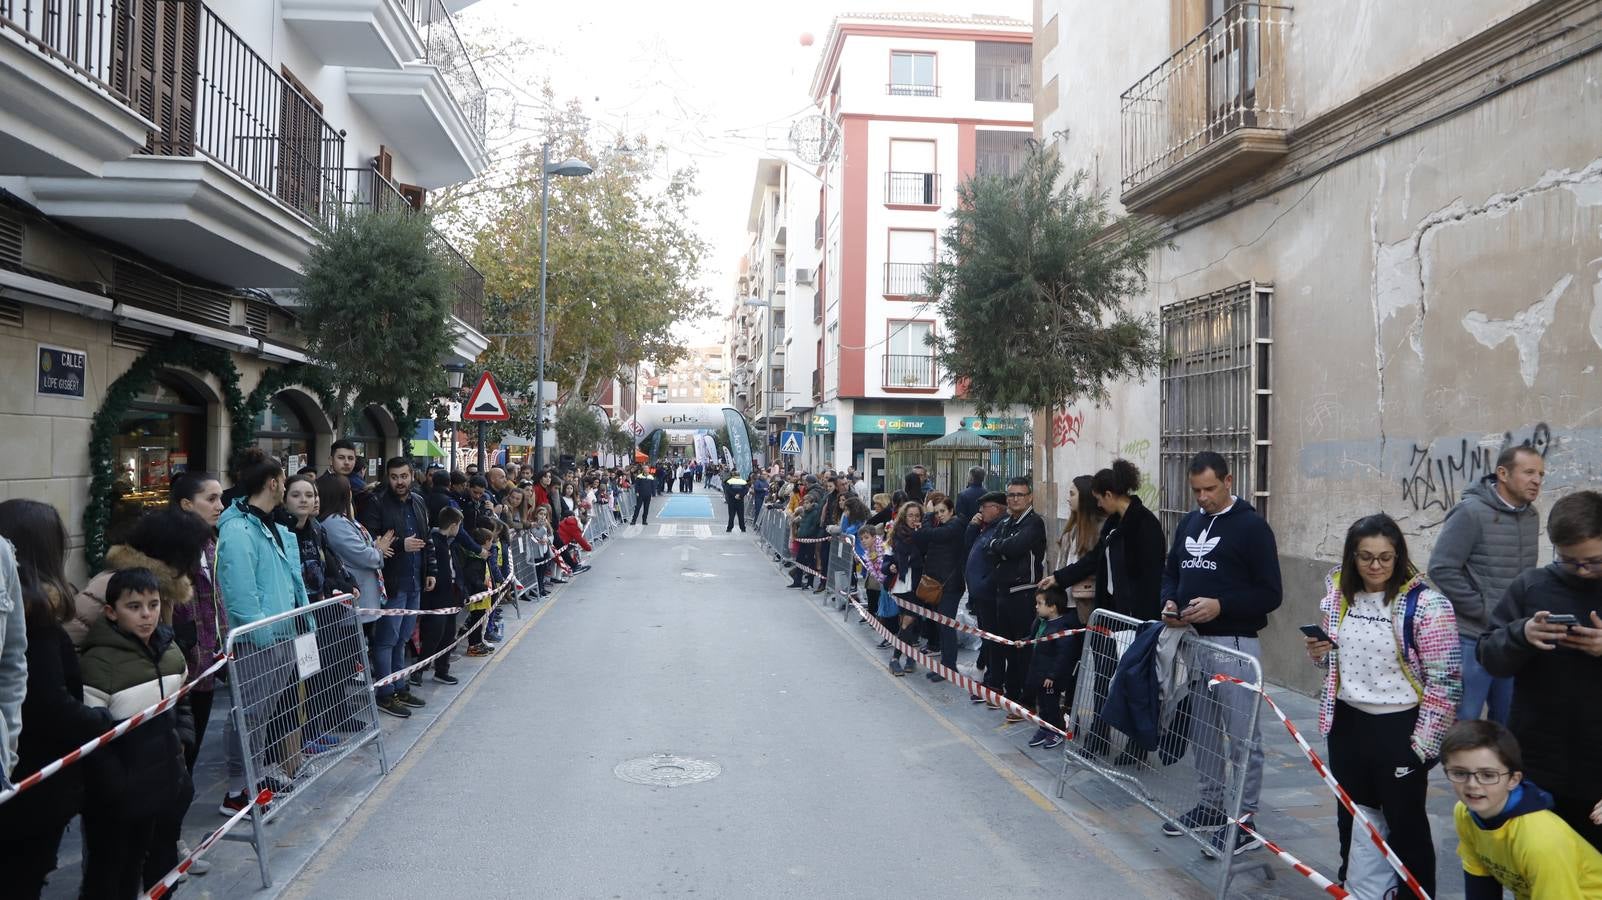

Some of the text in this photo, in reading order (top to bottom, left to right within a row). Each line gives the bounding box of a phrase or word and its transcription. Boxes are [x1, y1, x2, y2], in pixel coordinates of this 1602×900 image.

[61, 353, 83, 369] CALLE
[43, 376, 80, 391] LOPE GISBERT
[662, 414, 698, 424] dpts
[813, 415, 829, 426] 24h
[888, 420, 924, 430] cajamar
[1181, 557, 1217, 570] adidas
